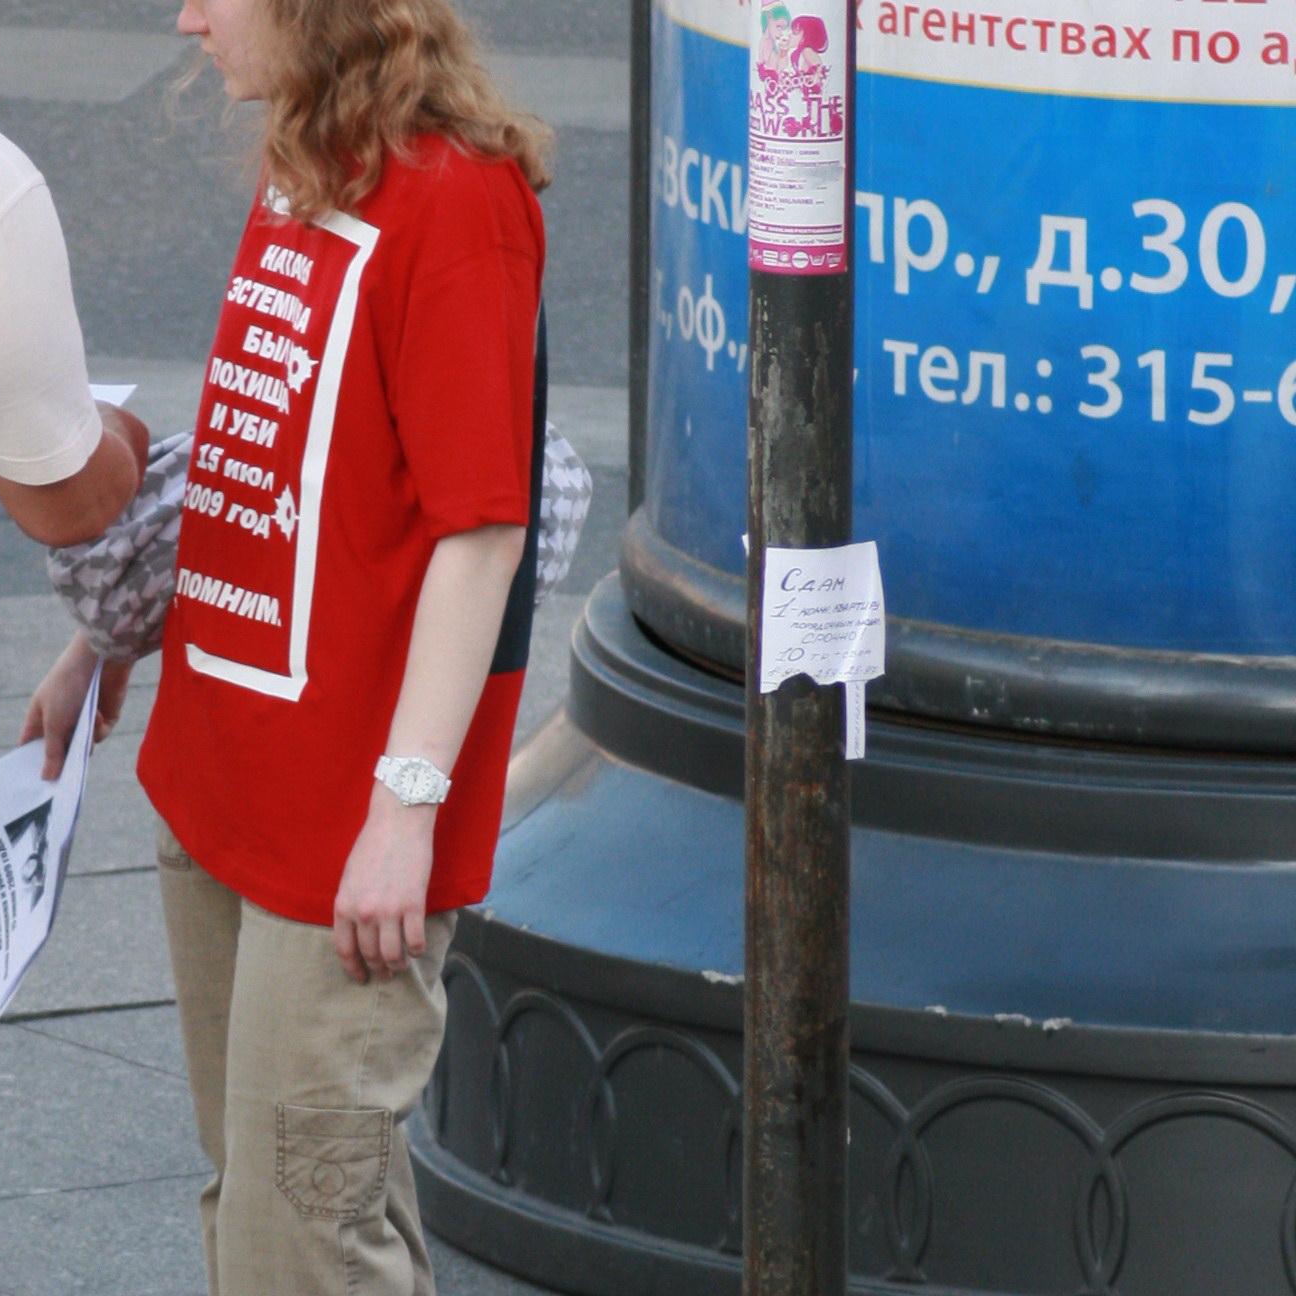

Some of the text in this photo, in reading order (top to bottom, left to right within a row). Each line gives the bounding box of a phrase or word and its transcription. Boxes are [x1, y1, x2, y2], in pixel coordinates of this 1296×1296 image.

[878, 0, 1151, 60] агентствах
[1172, 28, 1241, 64] по
[1261, 30, 1296, 76] а
[1026, 198, 1296, 314] д.30,
[882, 338, 1053, 415] тел.:
[196, 443, 225, 473] 15
[209, 402, 279, 448] И УБИ
